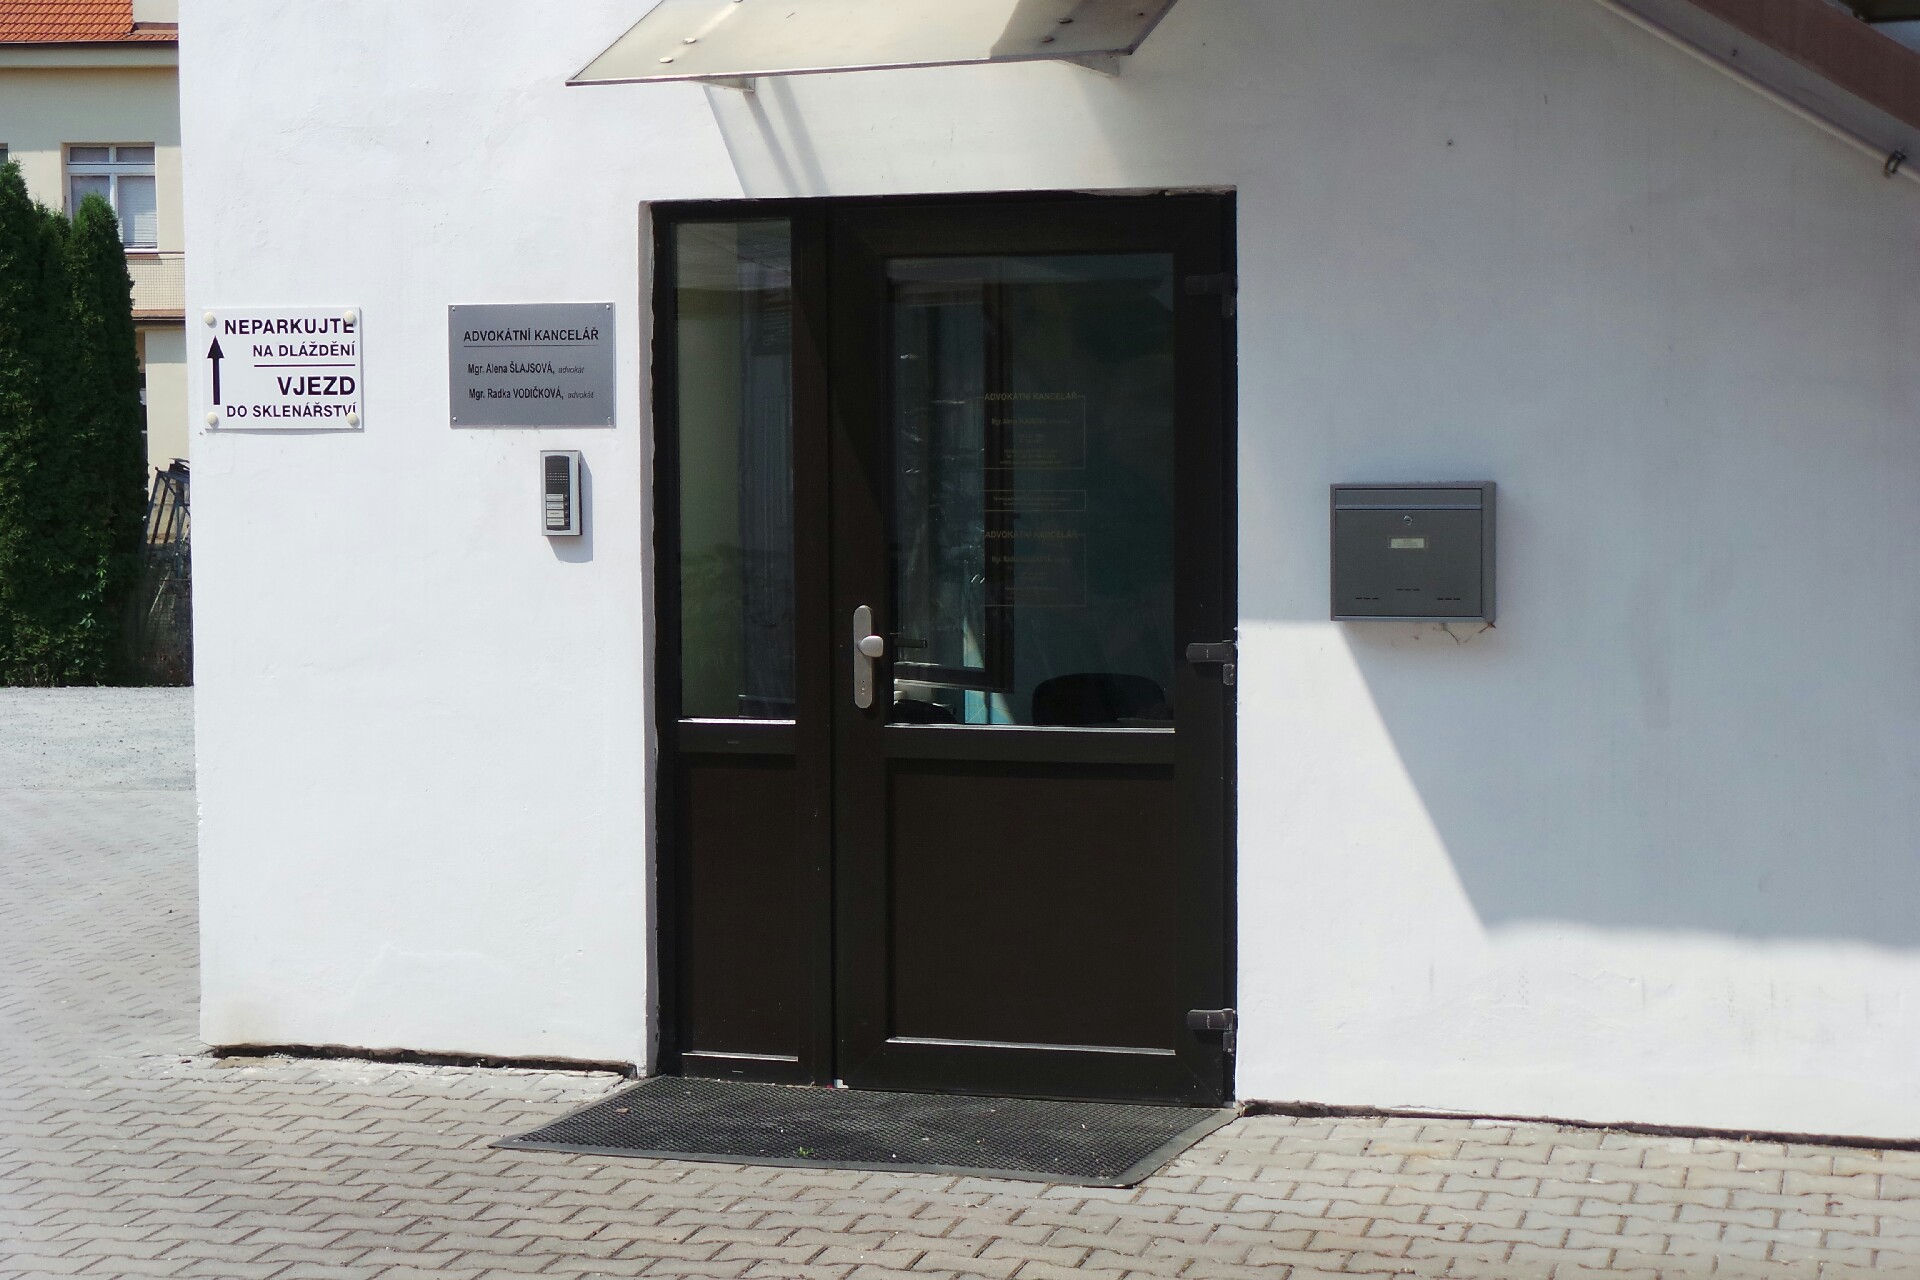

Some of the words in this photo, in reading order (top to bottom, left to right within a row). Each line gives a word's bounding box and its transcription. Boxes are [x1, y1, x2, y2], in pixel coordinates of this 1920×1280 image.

[224, 318, 355, 335] NEPARKUJTE
[463, 327, 531, 342] ADVOKÁTNÍ
[534, 326, 599, 341] KANCELÁŘ
[253, 344, 273, 357] NA
[278, 340, 355, 357] DLÁŽDĚNÍ
[467, 363, 484, 375] Mgr.
[486, 363, 508, 373] Alena
[509, 361, 555, 375] ŠLAJSOVÁ,
[277, 376, 356, 396] VJEZD
[469, 388, 484, 400] Mgr.
[487, 388, 511, 399] Radka
[512, 386, 564, 400] VODIČKOVÁ,
[226, 405, 247, 418] DO
[252, 402, 357, 418] SKLENÁŘSTVÍ
